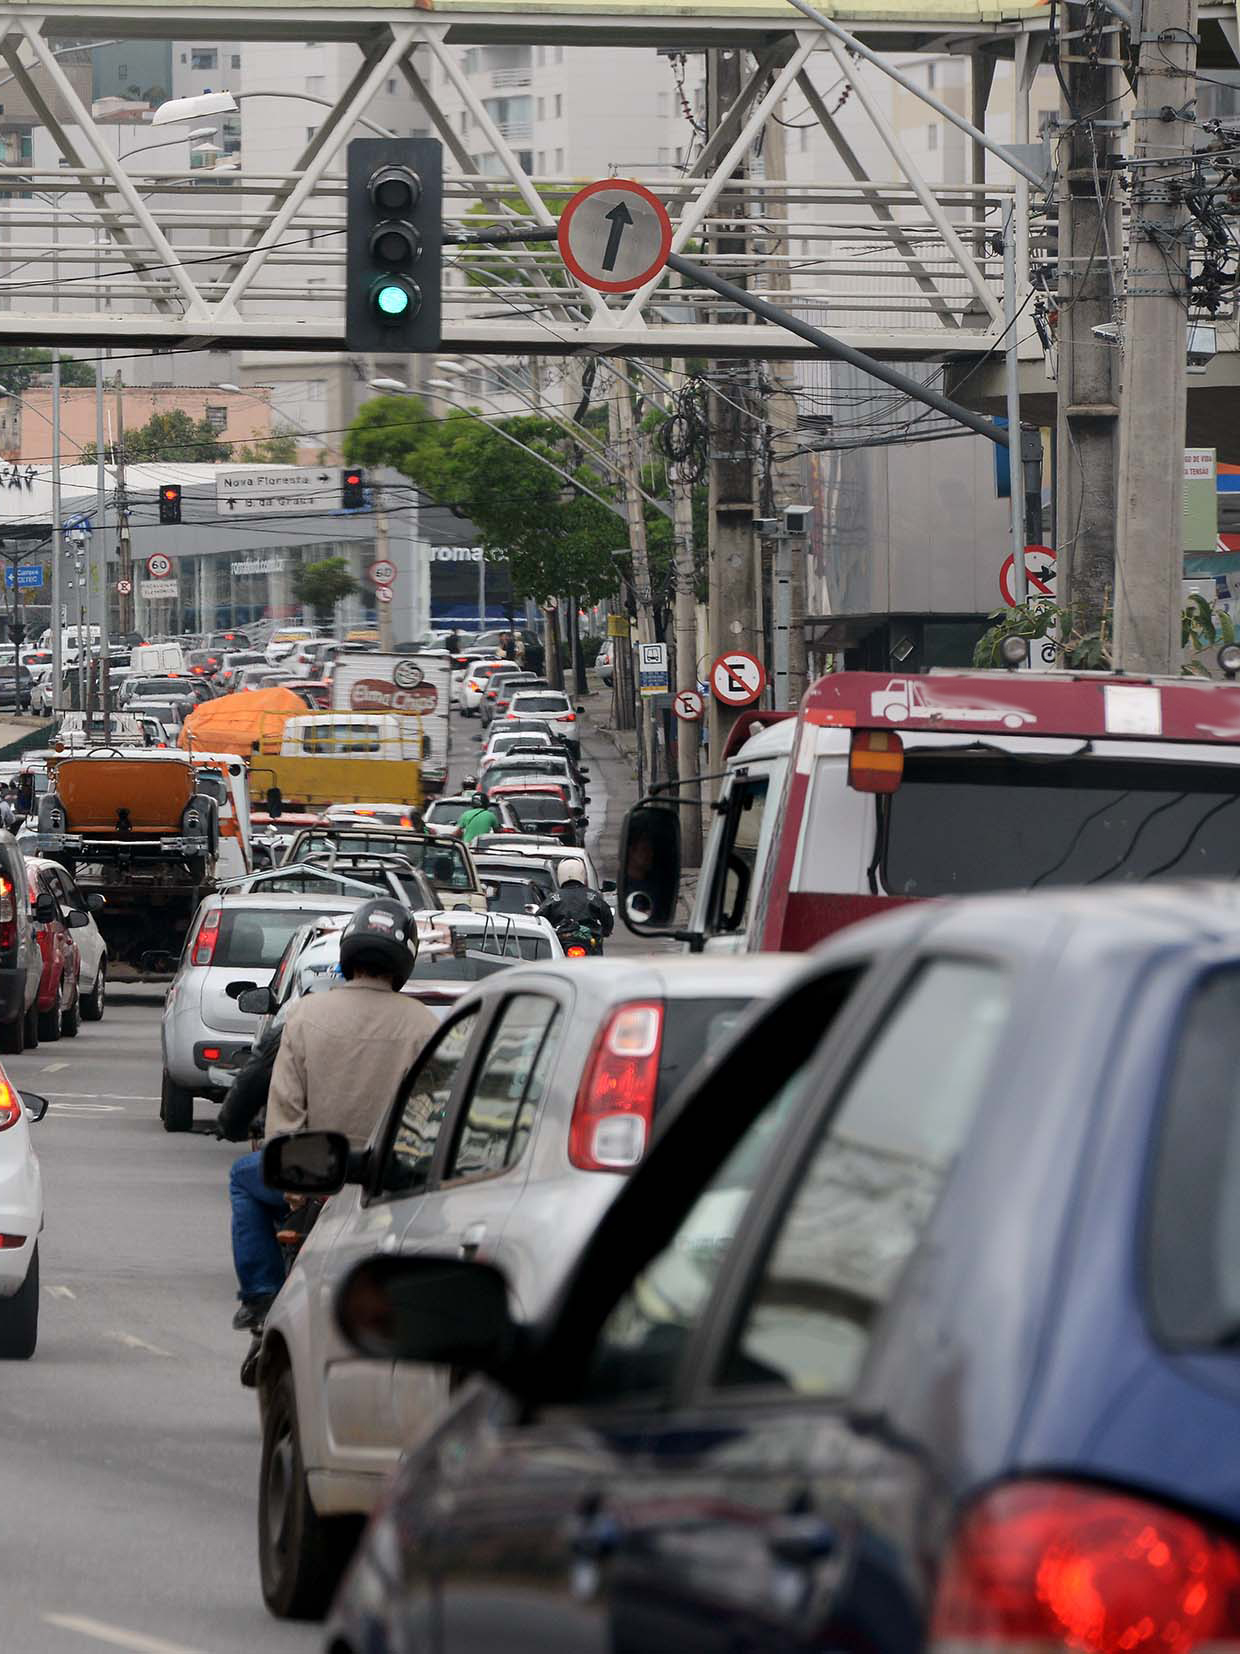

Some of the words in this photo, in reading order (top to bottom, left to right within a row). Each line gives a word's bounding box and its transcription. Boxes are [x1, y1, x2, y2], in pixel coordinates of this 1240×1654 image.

[224, 478, 253, 487] Nova
[257, 476, 310, 486] Floresta
[152, 560, 168, 570] 60
